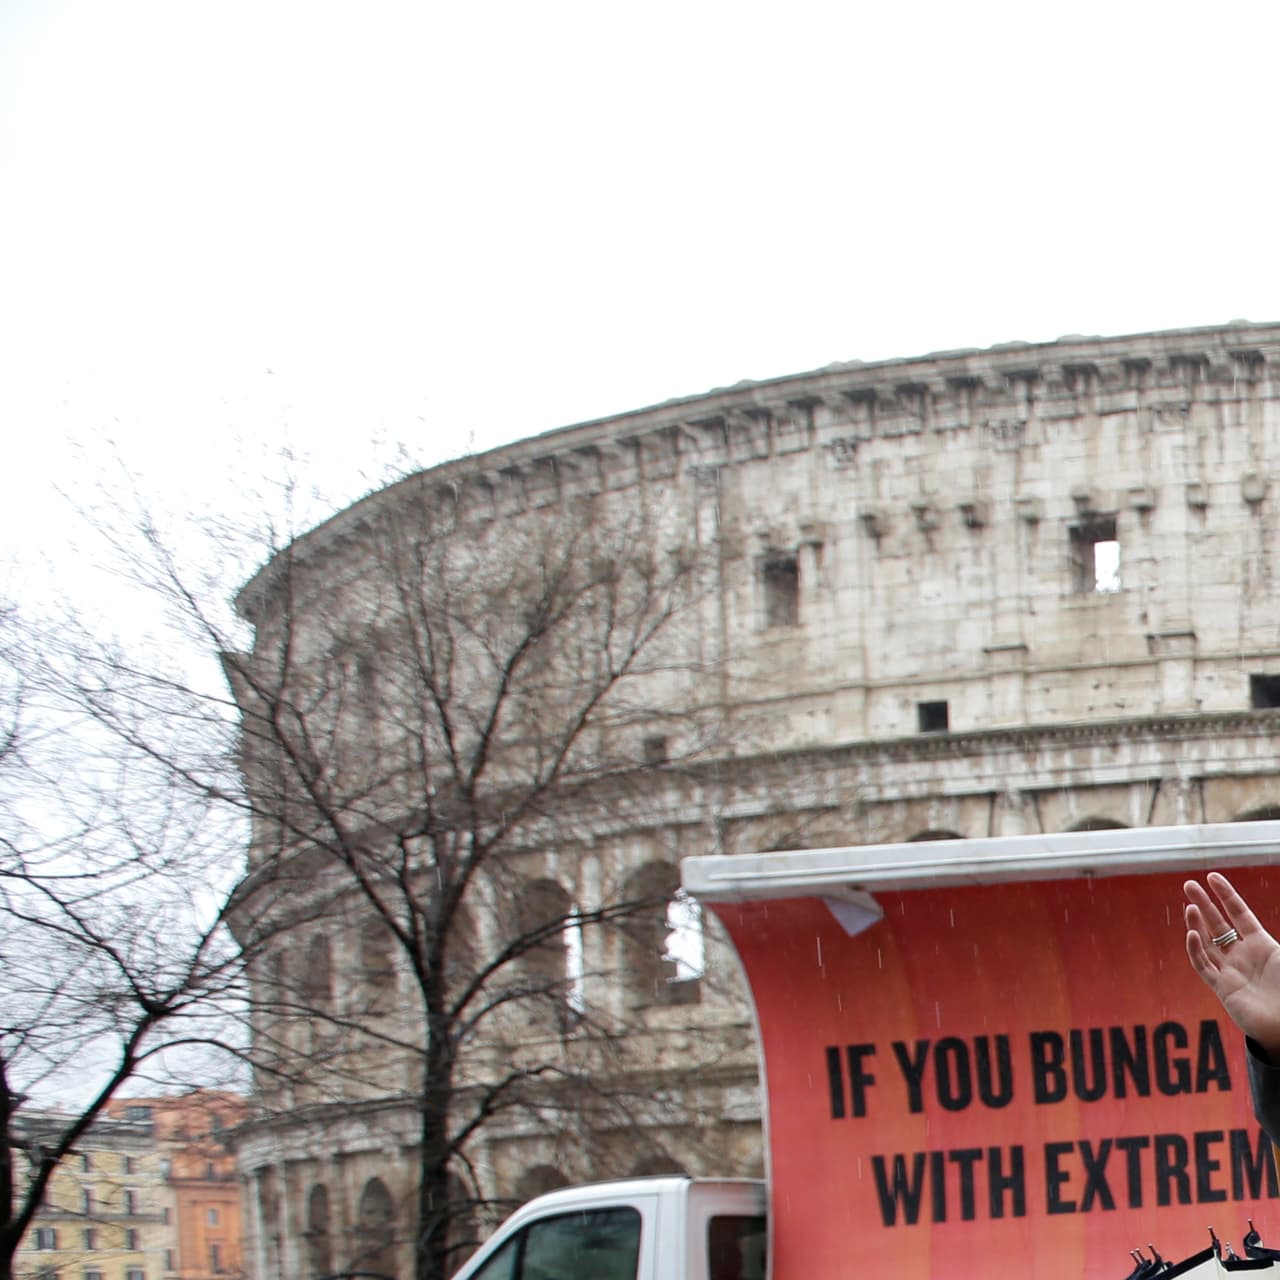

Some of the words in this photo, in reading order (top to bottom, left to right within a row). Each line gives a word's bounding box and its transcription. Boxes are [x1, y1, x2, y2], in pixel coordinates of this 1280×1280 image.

[826, 1044, 877, 1119] IF
[893, 1034, 1014, 1113] YOU
[1030, 1020, 1231, 1105] BUNGA
[872, 1144, 1026, 1227] WITH
[1045, 1128, 1280, 1215] EXTREM
